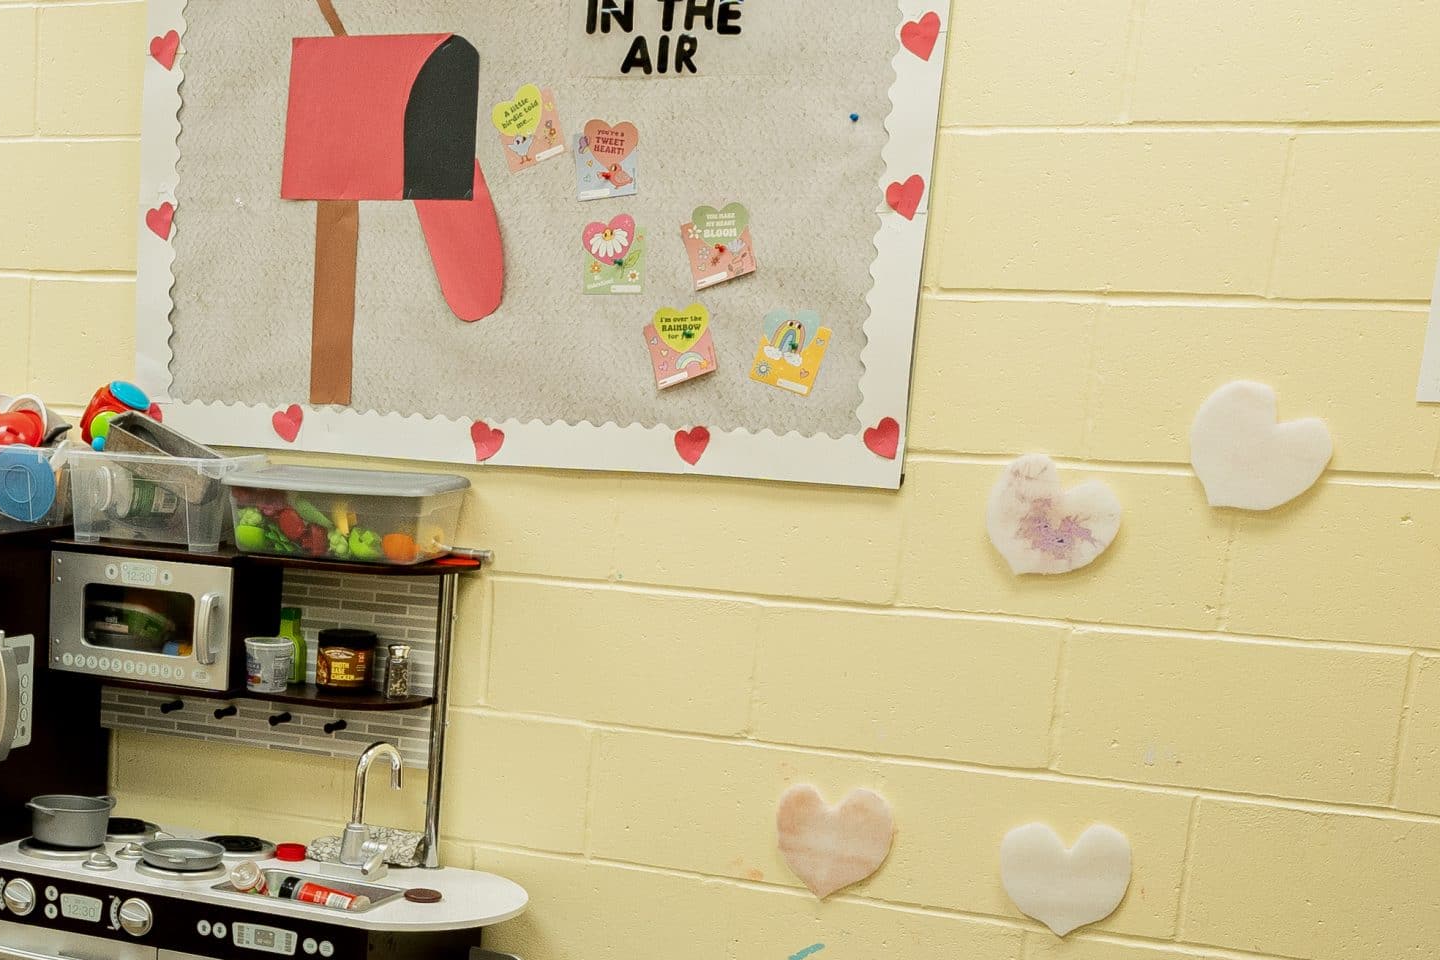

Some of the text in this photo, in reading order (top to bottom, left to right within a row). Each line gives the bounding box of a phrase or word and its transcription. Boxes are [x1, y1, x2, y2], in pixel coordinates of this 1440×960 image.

[586, 0, 744, 35] IN THE
[620, 33, 698, 75] AIR
[510, 98, 529, 113] little
[502, 100, 539, 129] birdie told
[595, 136, 625, 146] TWEET
[593, 145, 624, 155] HEART!
[703, 228, 736, 238] BLOOM
[662, 323, 701, 332] RAINBOW
[126, 571, 151, 582] 12:30
[68, 904, 95, 918] 12:30
